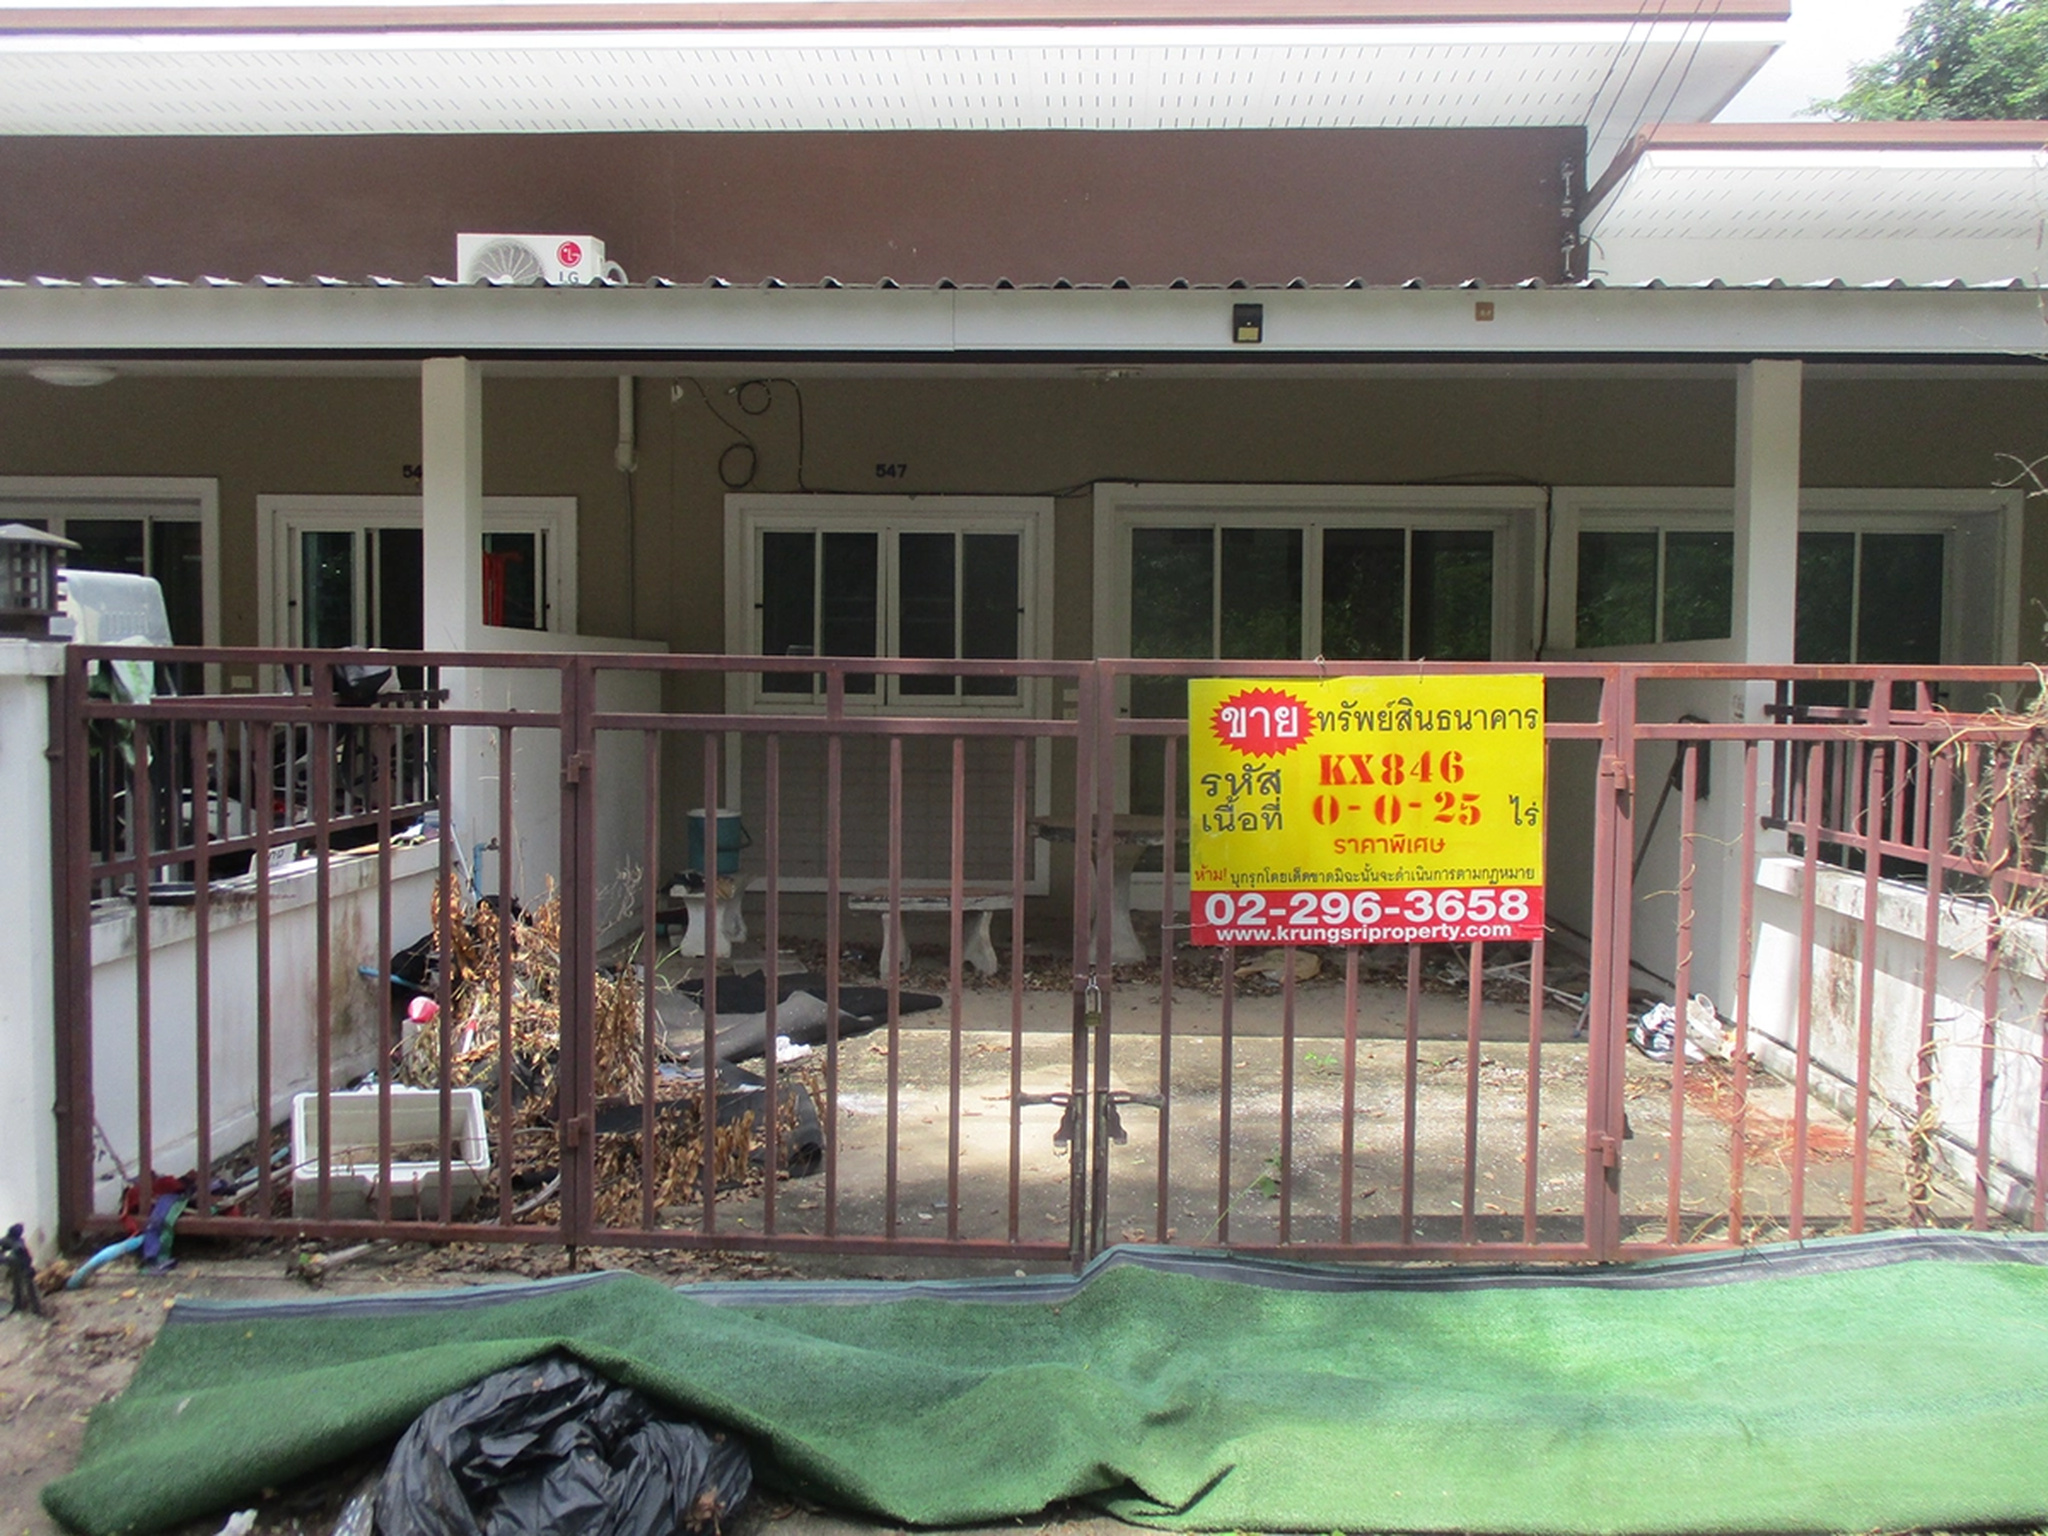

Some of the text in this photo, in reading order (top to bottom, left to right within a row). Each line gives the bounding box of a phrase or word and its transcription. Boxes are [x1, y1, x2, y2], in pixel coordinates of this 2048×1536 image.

[876, 463, 907, 478] 547
[1221, 706, 1298, 738] ขาย
[1317, 697, 1539, 732] ทรัพย์สินธนาคาร
[1201, 750, 1465, 797] รหัส KX846
[1202, 795, 1283, 832] เนื้อที่
[1509, 794, 1540, 826] ไร่
[1334, 834, 1446, 854] ราคาพิเศษ
[1205, 889, 1529, 926] 02-296-3658
[1216, 923, 1512, 943] www.krungsriproperty.com
